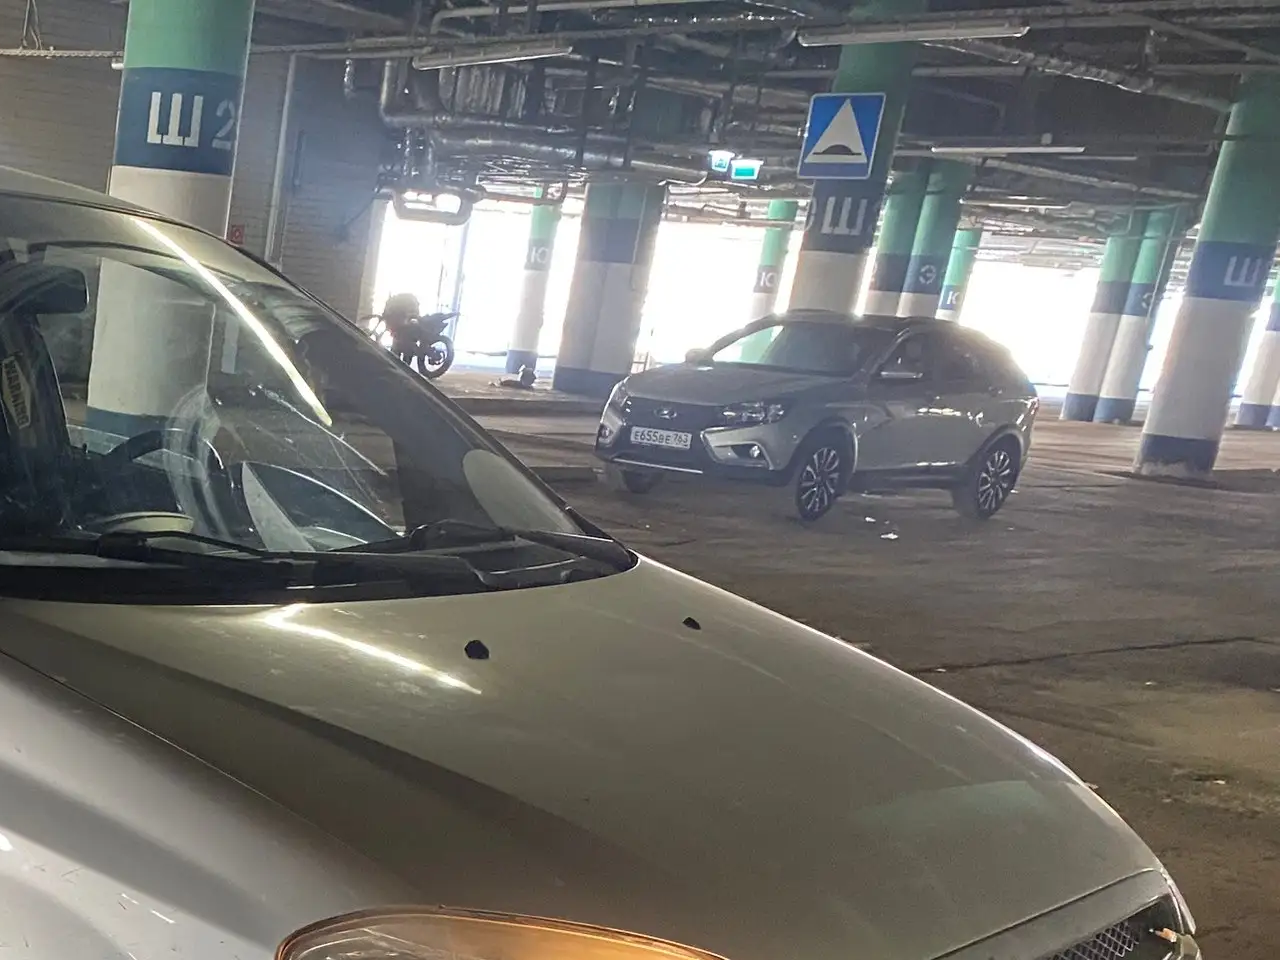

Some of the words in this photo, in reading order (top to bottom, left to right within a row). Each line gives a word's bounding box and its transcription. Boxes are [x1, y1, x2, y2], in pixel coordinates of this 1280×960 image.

[146, 91, 204, 147] Ш
[211, 99, 236, 150] 2
[820, 196, 868, 236] Ш
[1223, 256, 1262, 287] Ш
